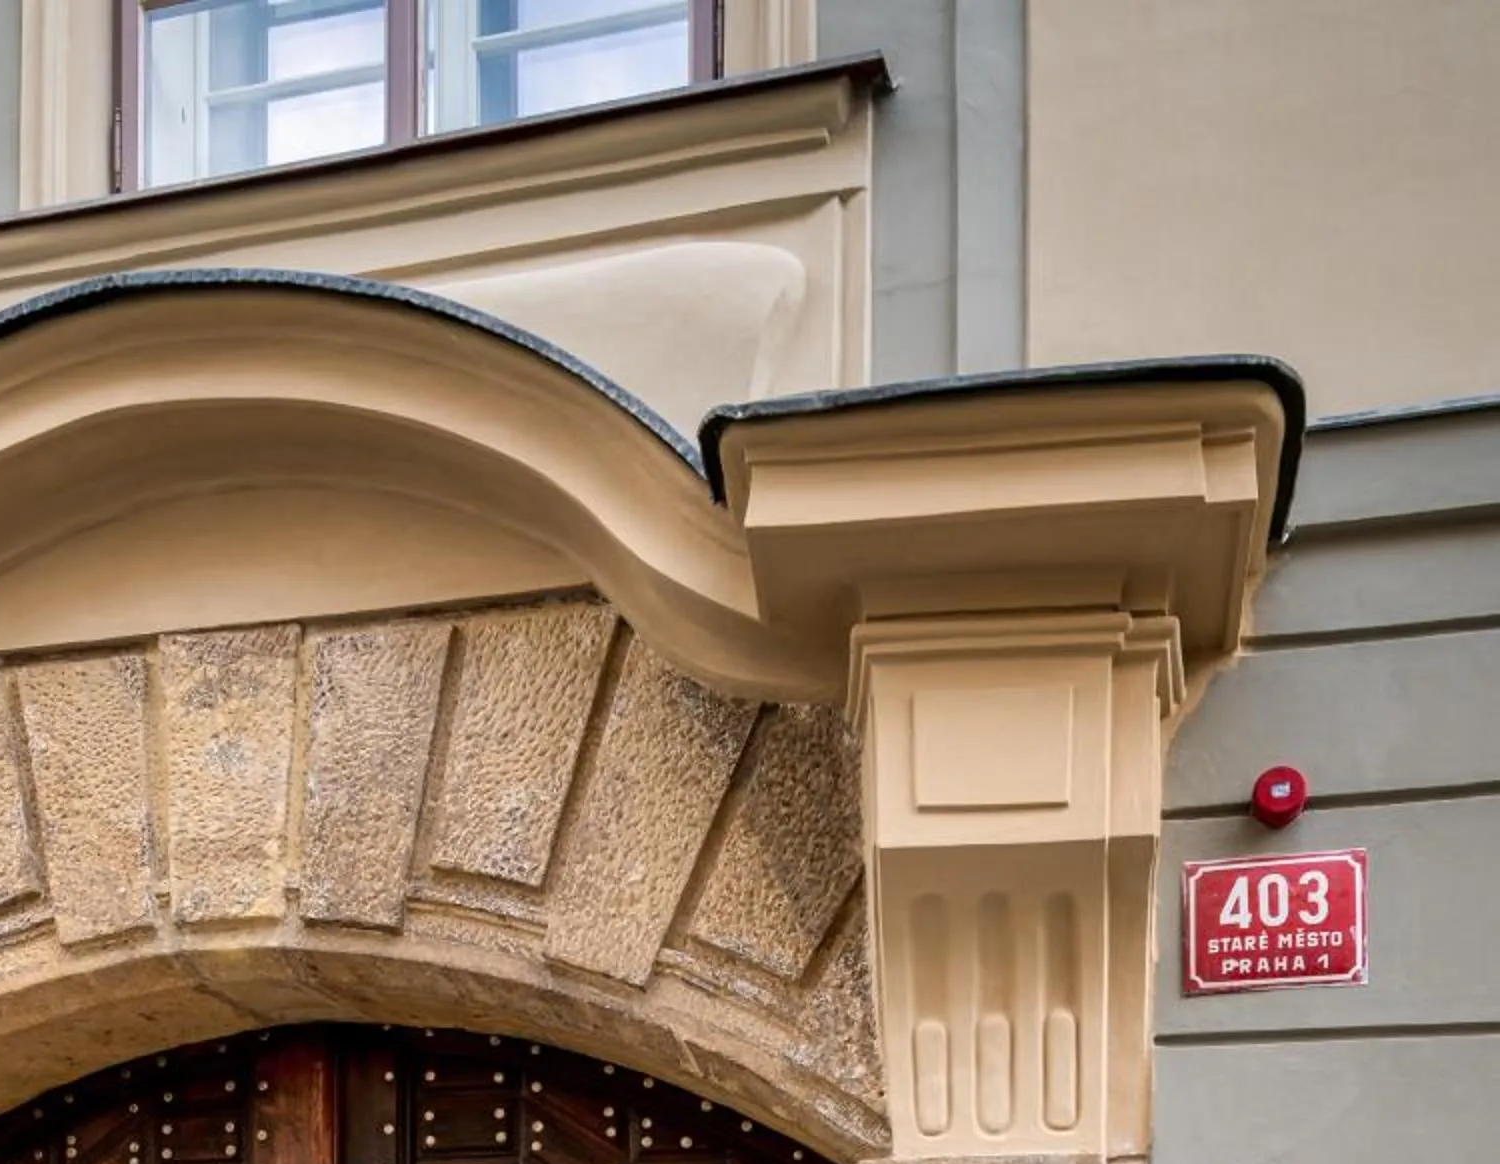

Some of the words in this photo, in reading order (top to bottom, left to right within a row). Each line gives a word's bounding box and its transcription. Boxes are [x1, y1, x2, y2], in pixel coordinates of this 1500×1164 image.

[1219, 869, 1330, 929] 403
[1208, 930, 1269, 954] STARÉ
[1278, 928, 1343, 949] MĚSTO
[1221, 955, 1306, 975] PRAHA
[1317, 953, 1330, 969] 1
